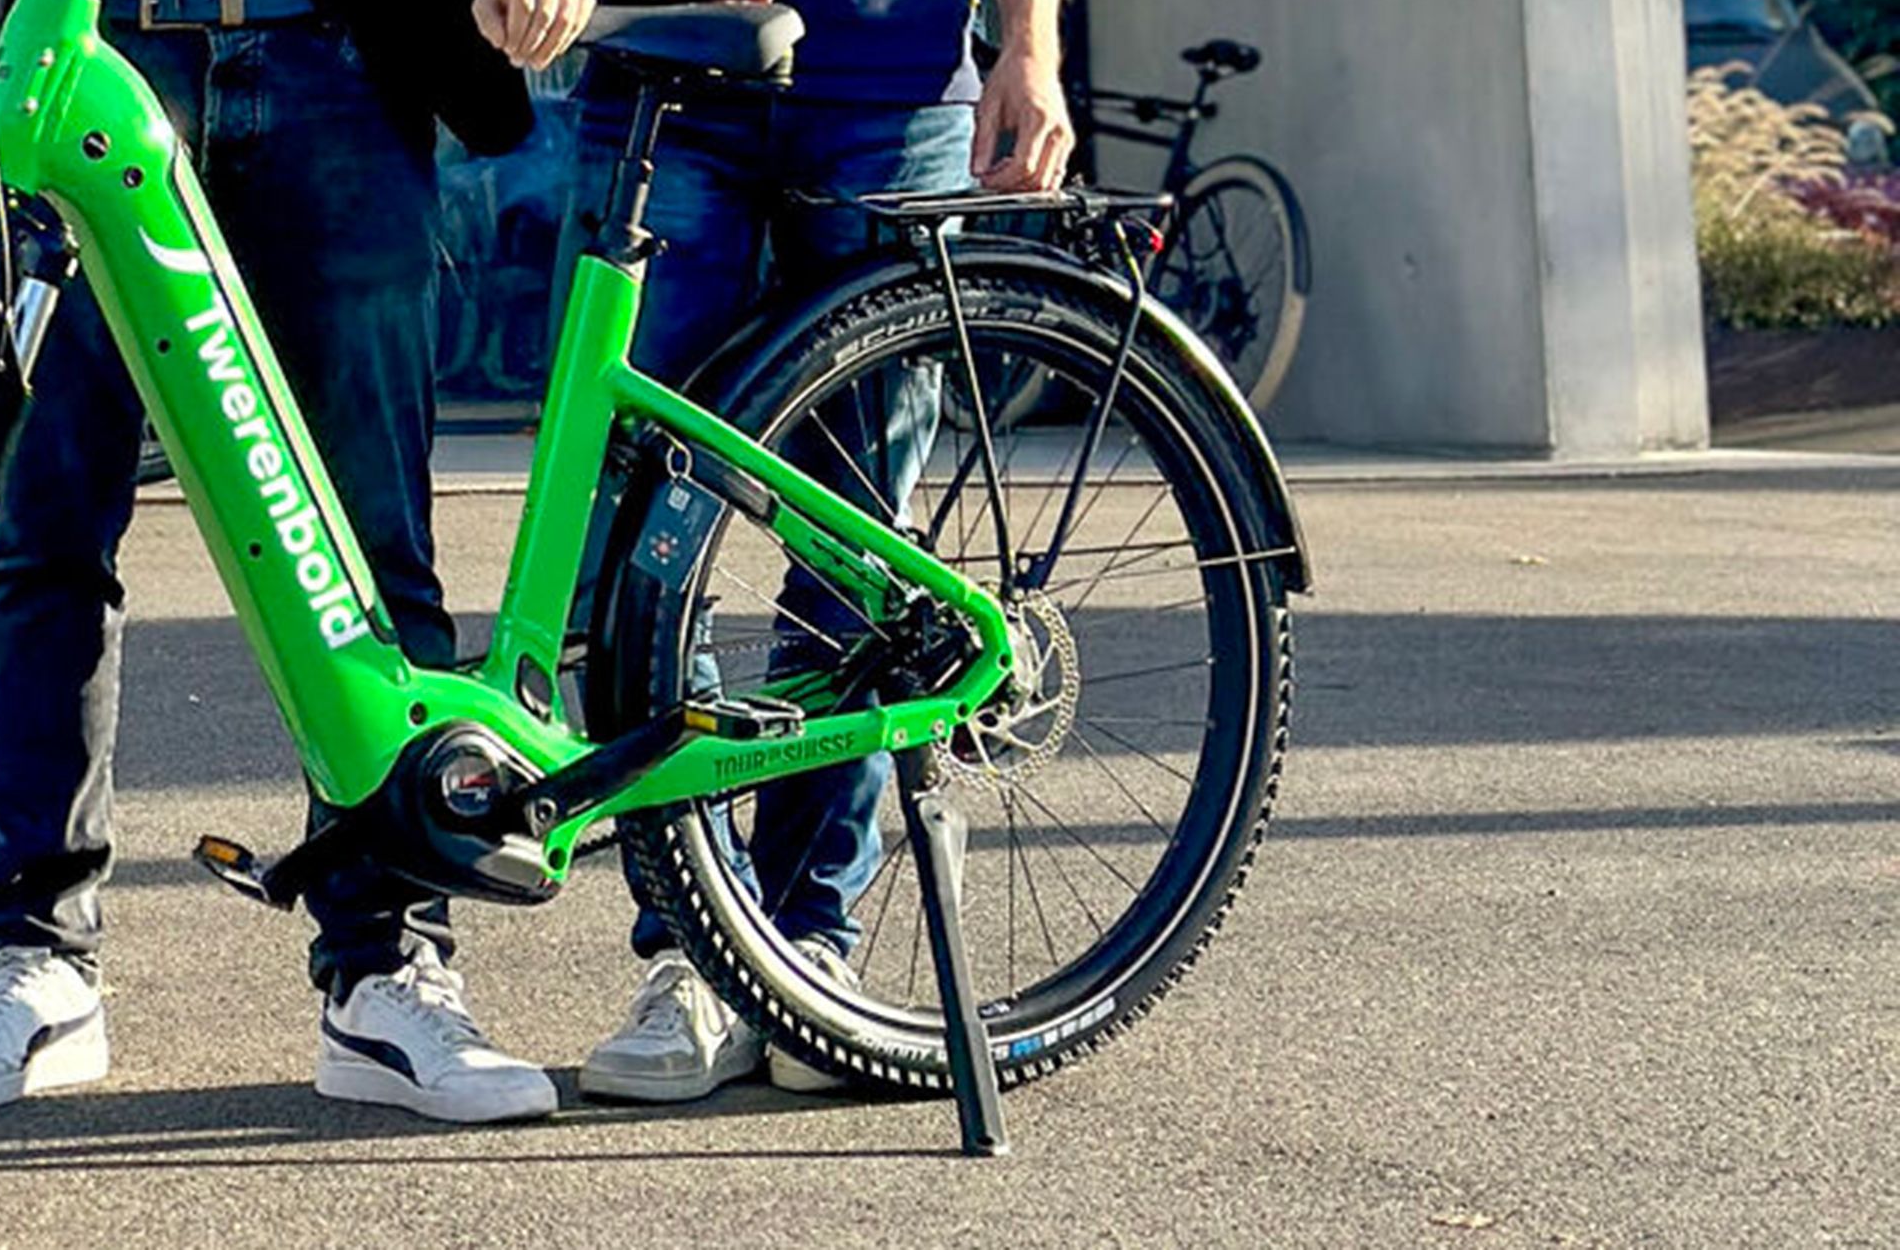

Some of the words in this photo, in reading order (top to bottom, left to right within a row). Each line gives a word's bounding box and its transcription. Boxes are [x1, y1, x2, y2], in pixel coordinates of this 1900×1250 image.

[185, 291, 370, 649] Twerenbold
[714, 750, 767, 777] TOUR
[782, 730, 856, 765] SUISSE
